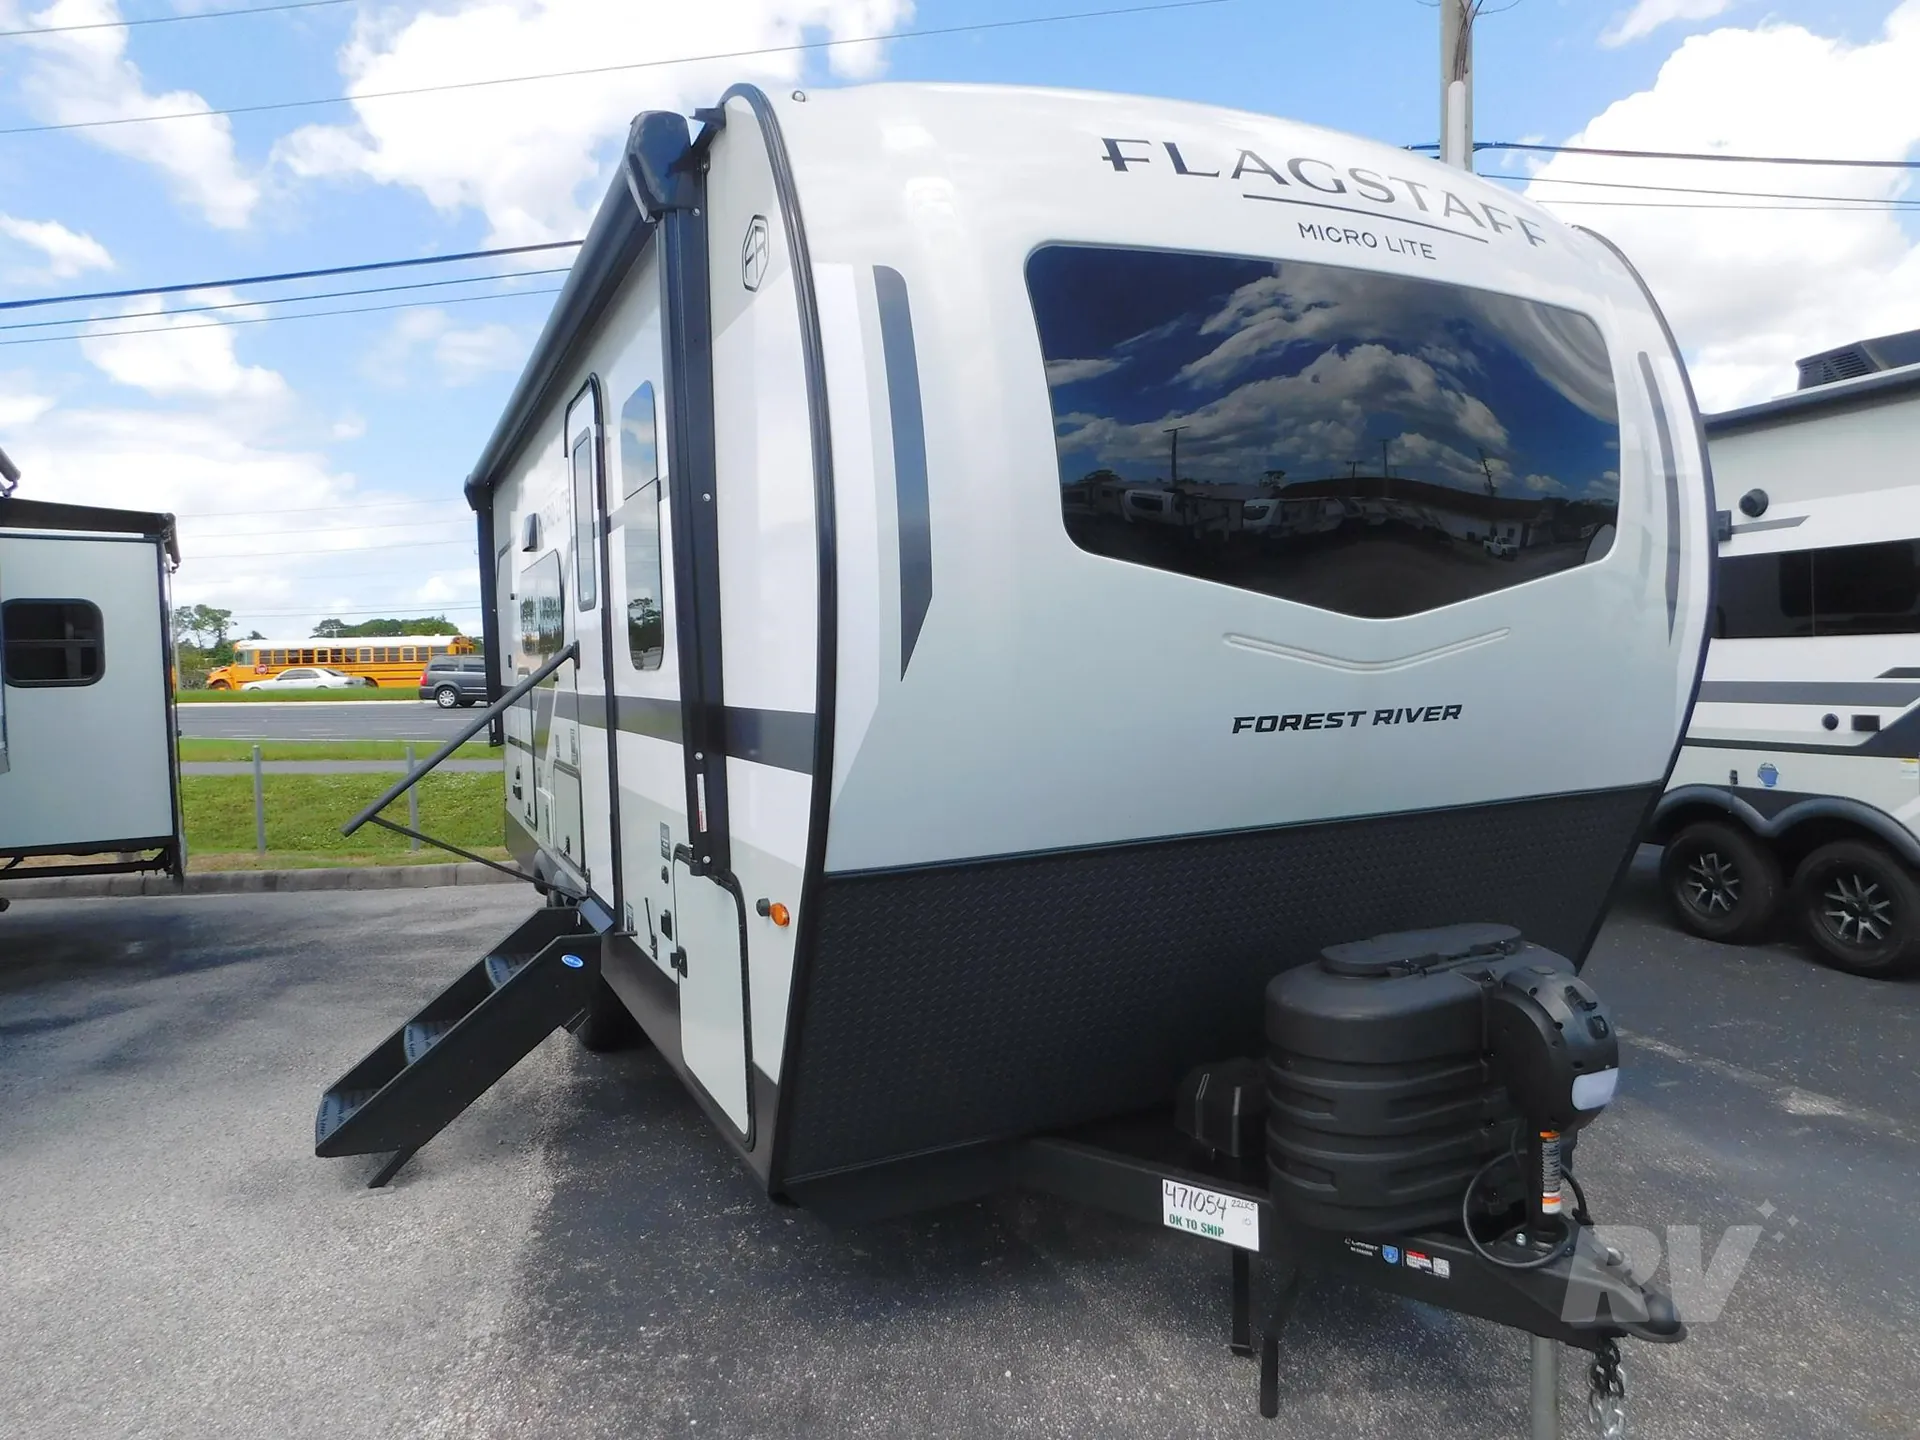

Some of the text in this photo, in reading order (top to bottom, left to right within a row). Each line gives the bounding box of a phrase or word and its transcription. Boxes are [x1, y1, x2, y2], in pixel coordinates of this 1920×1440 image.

[1101, 136, 1547, 248] FLAGSTAFF
[1298, 221, 1437, 261] MICRO LITE
[1231, 703, 1463, 734] FOREST RIVER
[1165, 1182, 1227, 1220] 471054
[1169, 1213, 1224, 1237] OK TO SHIP
